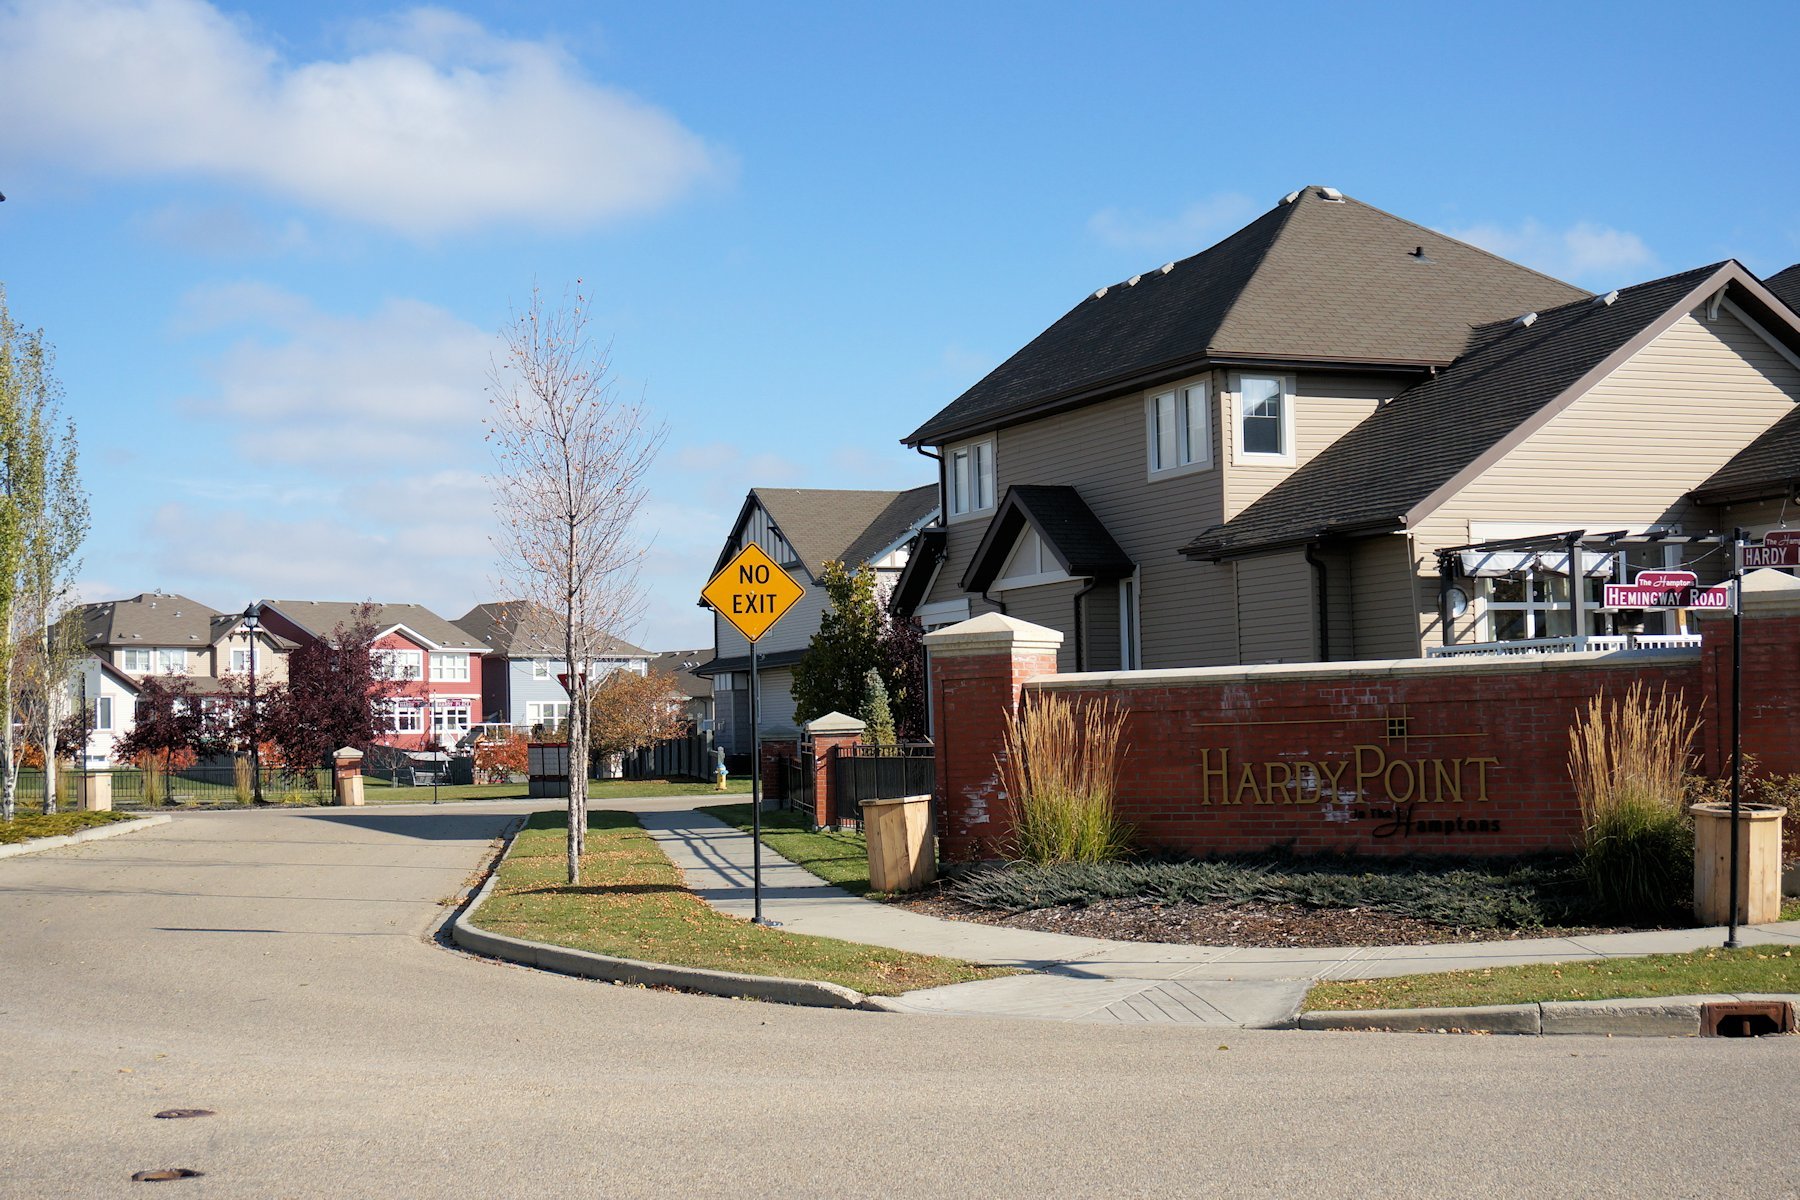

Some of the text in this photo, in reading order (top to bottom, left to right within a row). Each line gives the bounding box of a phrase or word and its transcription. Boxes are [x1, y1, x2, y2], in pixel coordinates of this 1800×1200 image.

[1745, 547, 1787, 565] HARDY
[740, 565, 769, 584] NO
[1653, 575, 1694, 588] Hamptons
[733, 594, 777, 613] EXIT
[1609, 588, 1724, 606] HEMINGWAY ROAD
[1370, 808, 1393, 818] The
[1372, 803, 1501, 838] Hamptons
